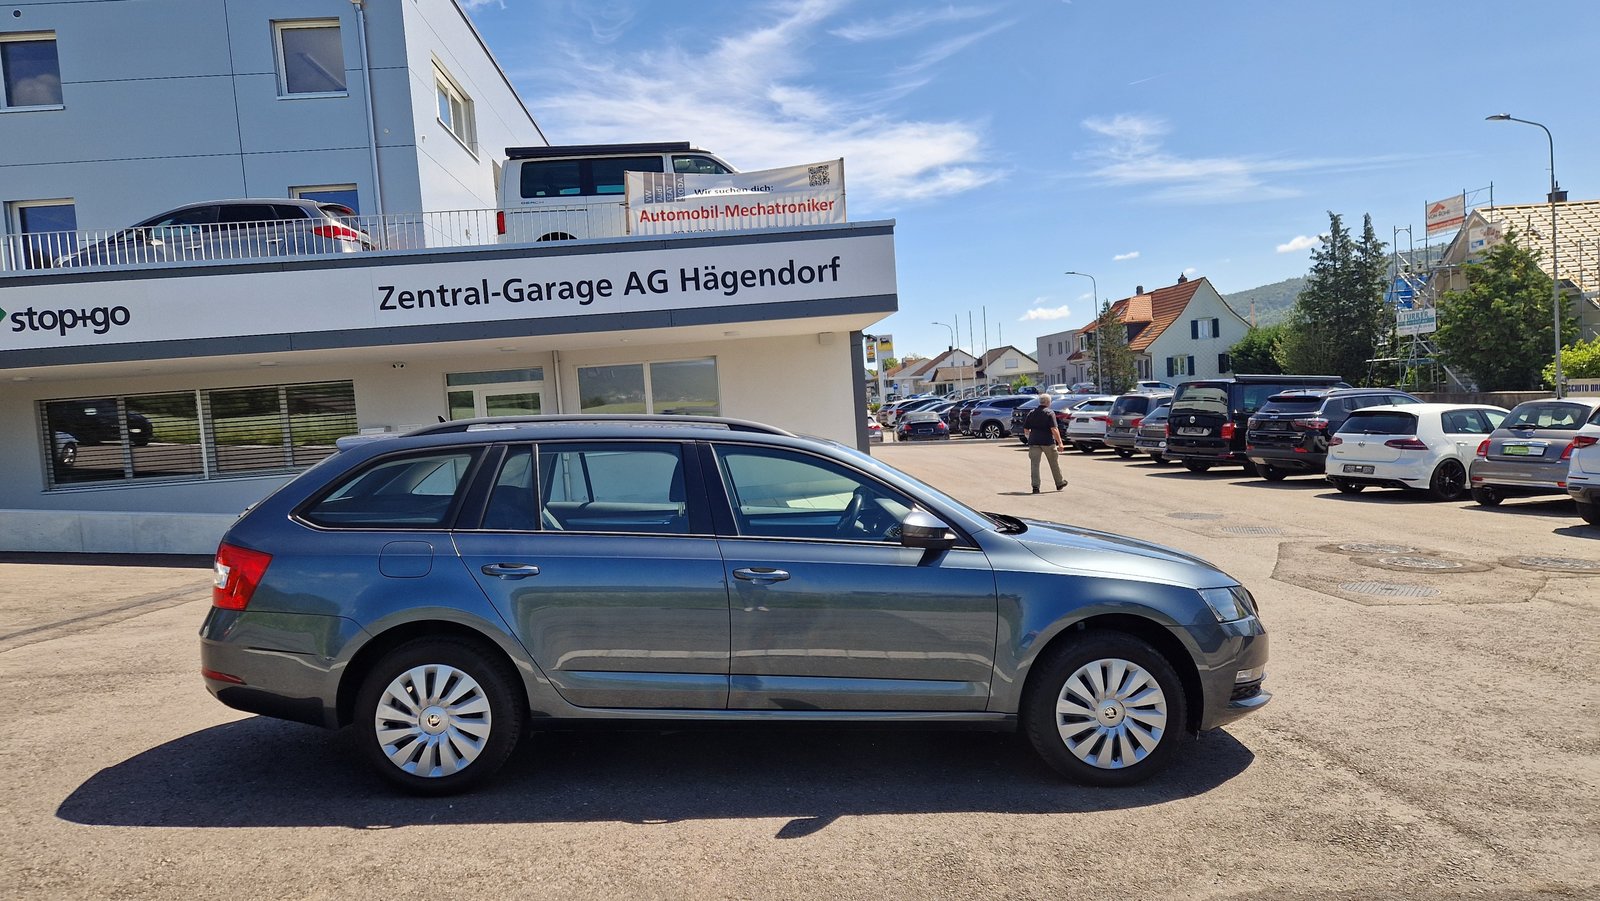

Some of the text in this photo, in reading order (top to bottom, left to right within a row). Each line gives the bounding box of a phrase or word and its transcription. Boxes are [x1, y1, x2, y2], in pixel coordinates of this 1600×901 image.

[751, 184, 774, 192] dich:
[639, 199, 835, 223] Automobil-Mechatroniker
[378, 255, 841, 311] Zentral-Garage AG Hägendorf
[10, 306, 131, 337] stop+go
